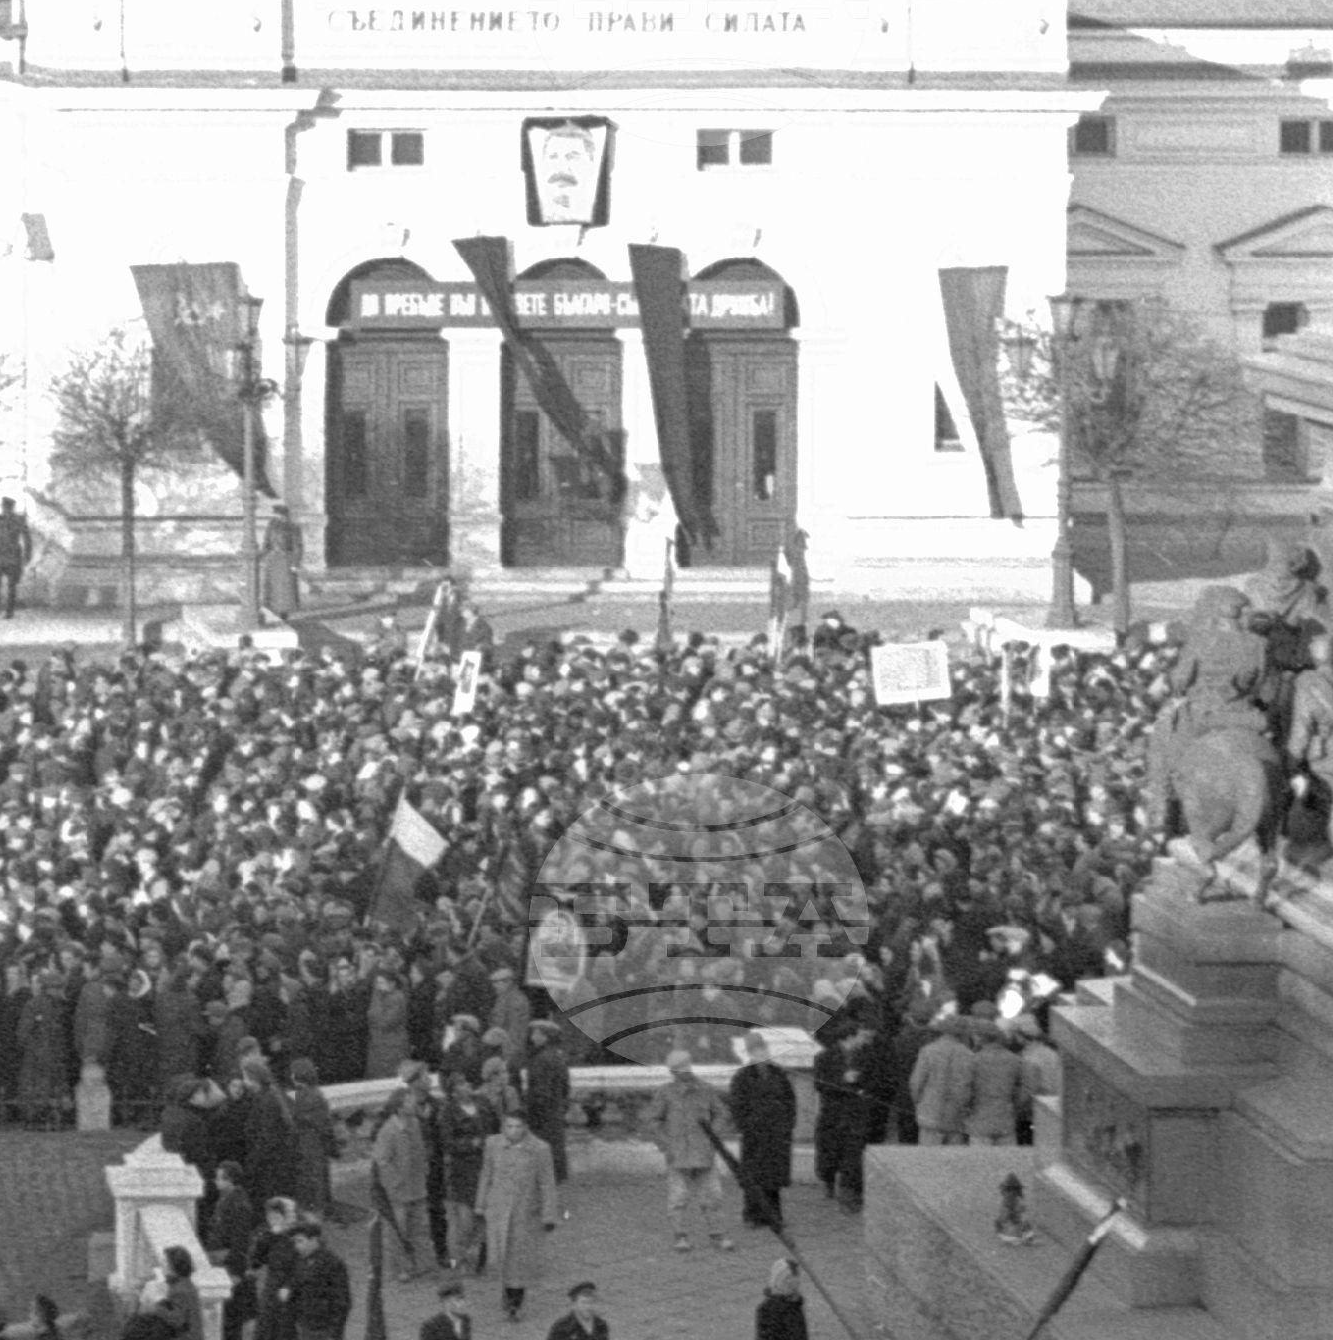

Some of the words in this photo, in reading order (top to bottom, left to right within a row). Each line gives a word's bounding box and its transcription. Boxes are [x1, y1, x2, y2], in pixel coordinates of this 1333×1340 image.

[327, 10, 560, 32] СЪЕДИНЕНИЕТО
[588, 10, 675, 32] ПРАВИ
[704, 10, 806, 33] СИЛАТА
